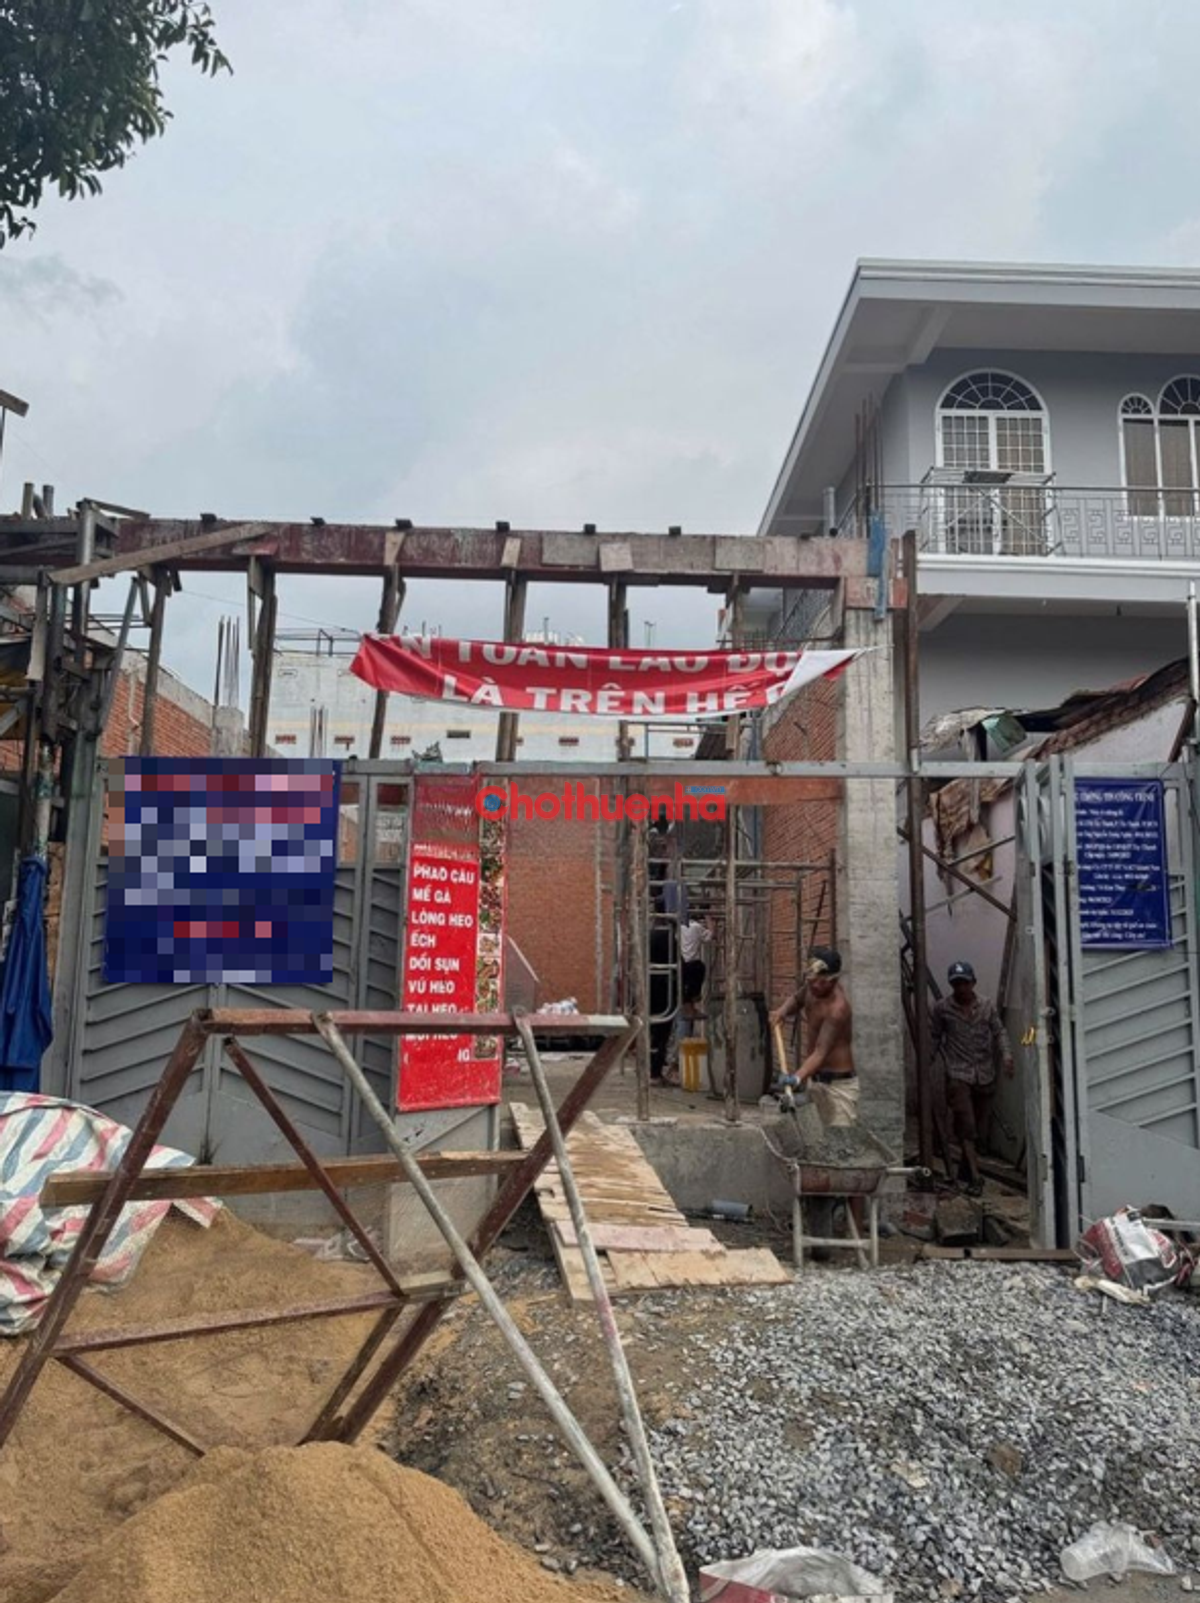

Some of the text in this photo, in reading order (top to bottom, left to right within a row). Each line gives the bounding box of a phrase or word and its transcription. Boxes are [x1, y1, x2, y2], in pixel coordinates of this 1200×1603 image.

[442, 674, 505, 707] LÀ
[525, 682, 666, 715] TRÊN
[448, 913, 474, 928] HEO
[429, 980, 456, 994] HEO
